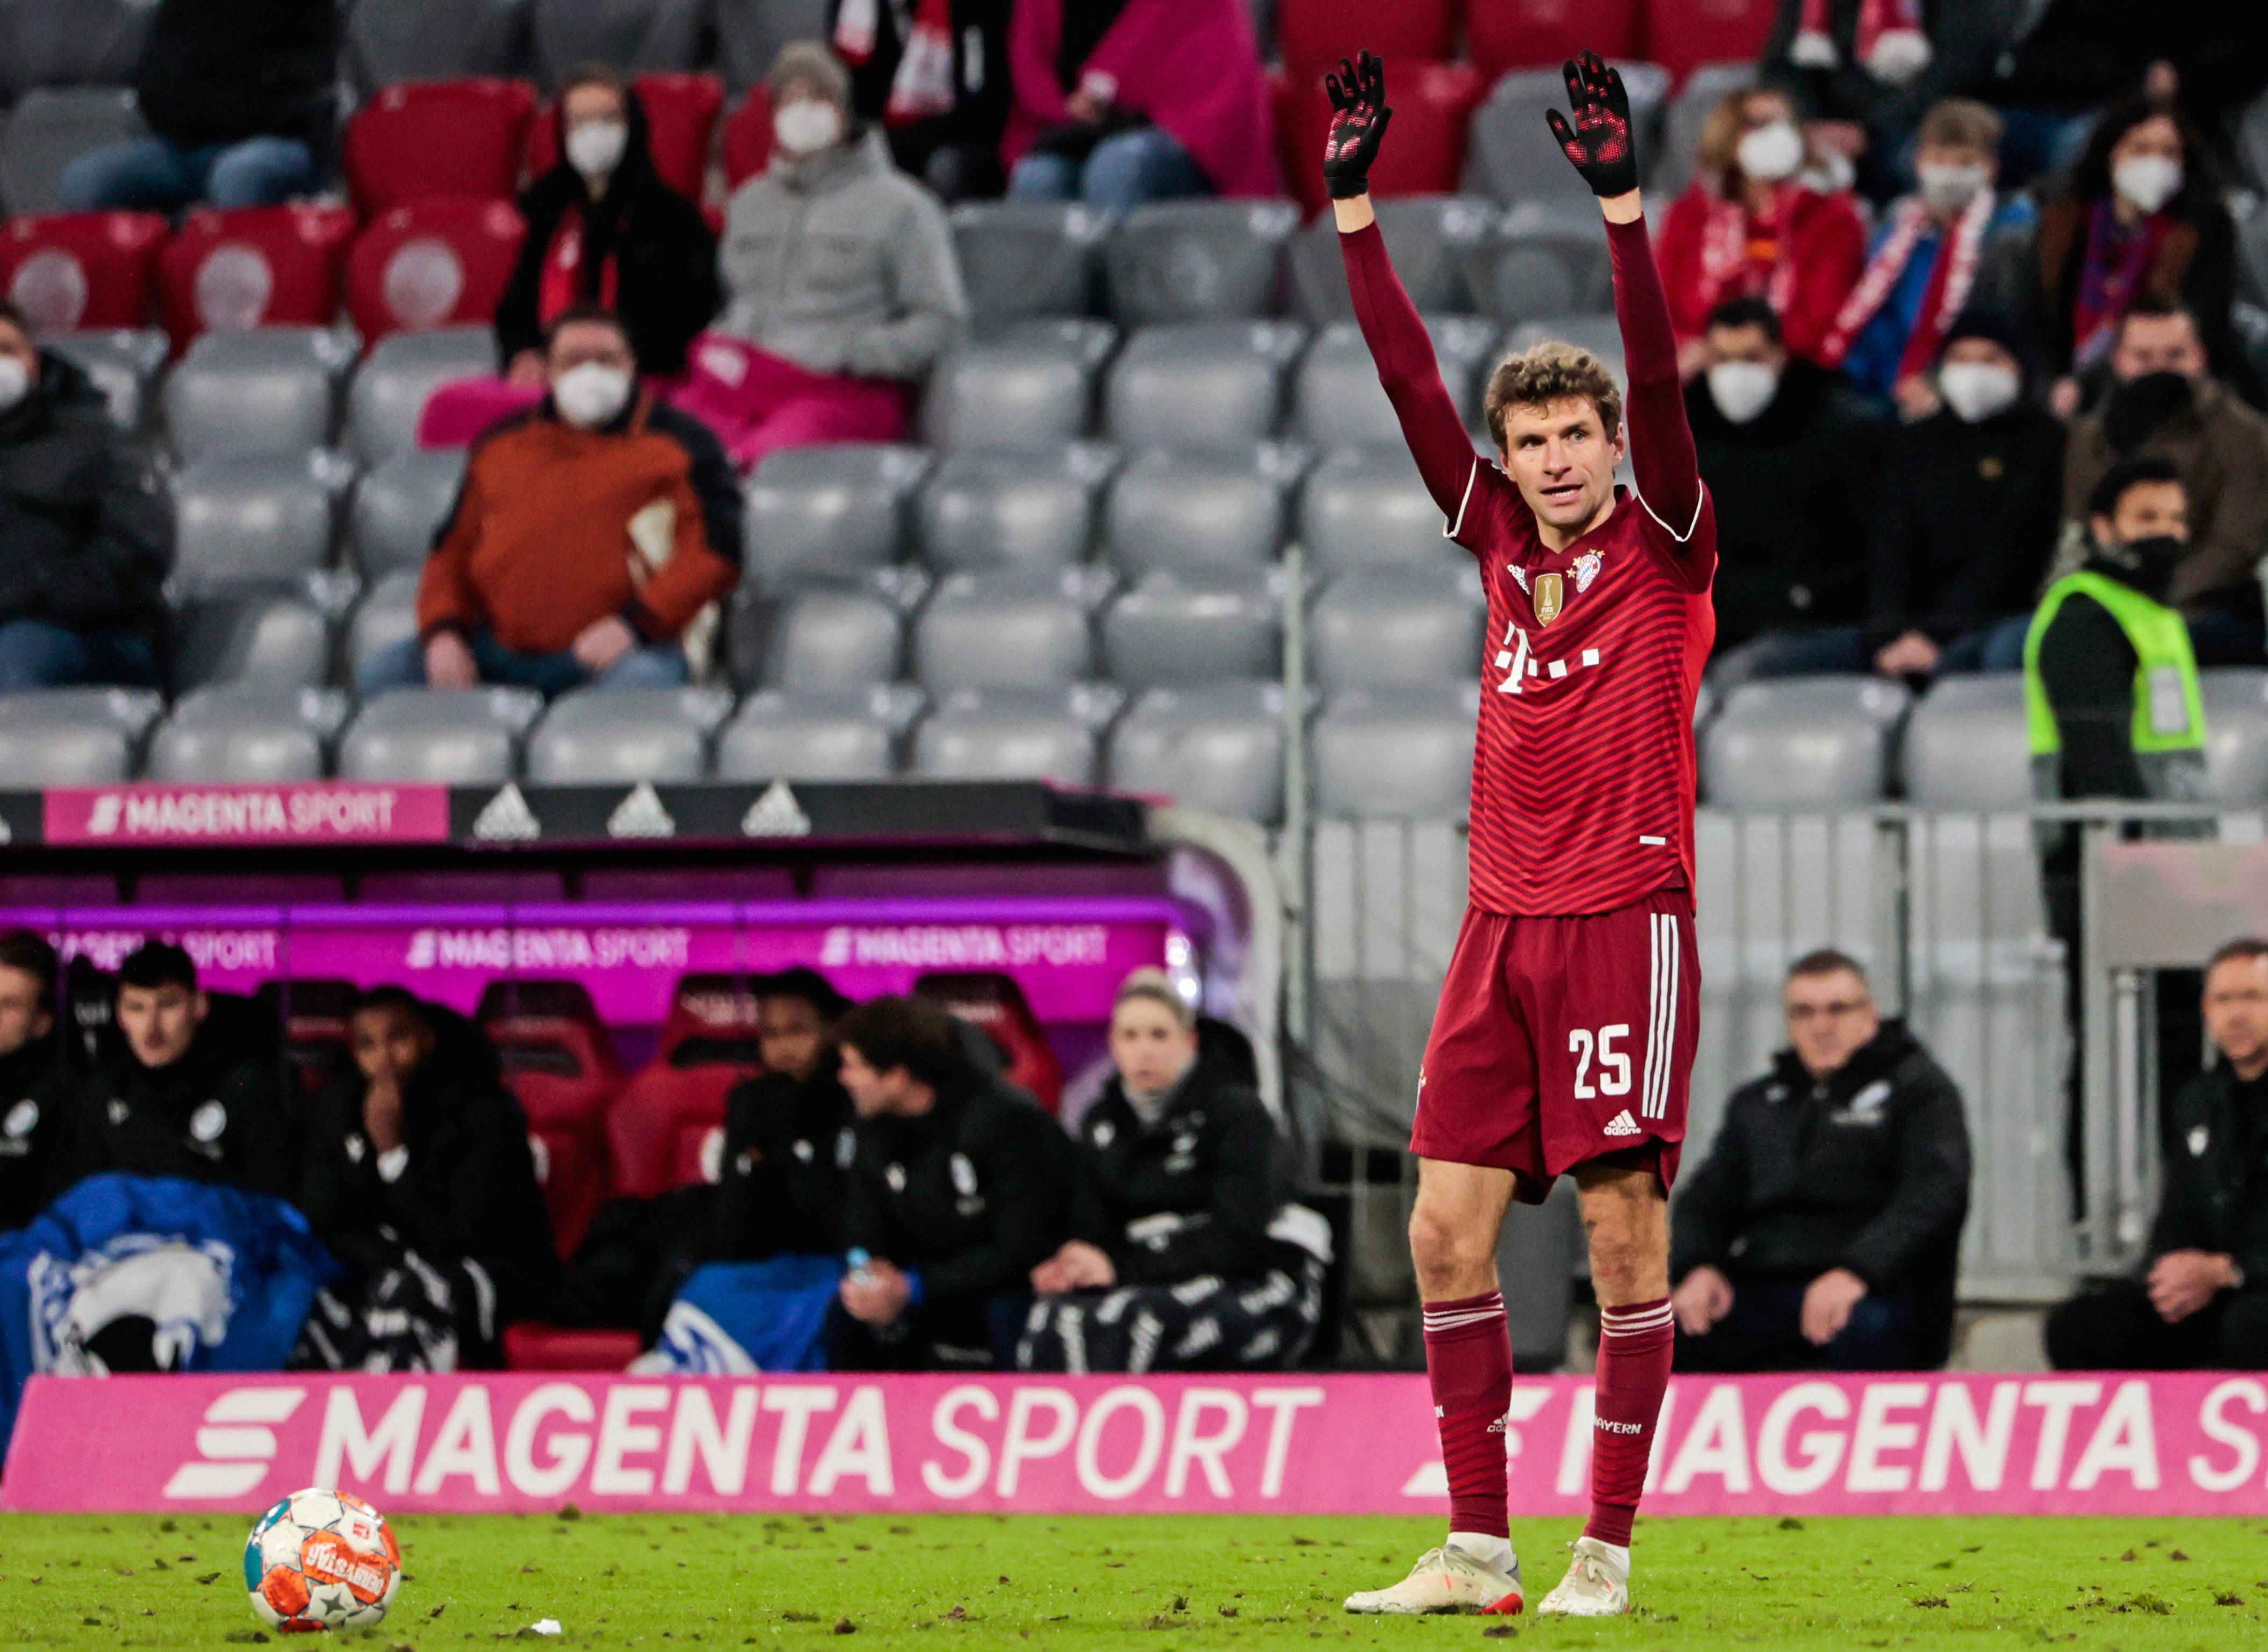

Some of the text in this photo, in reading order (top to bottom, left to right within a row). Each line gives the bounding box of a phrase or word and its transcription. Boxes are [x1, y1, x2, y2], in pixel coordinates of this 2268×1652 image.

[126, 791, 394, 835] MAGENTA SPORT
[438, 927, 689, 968] MAGENTA SPORT
[856, 925, 1107, 966] MAGENTA SPORT
[1569, 1023, 1631, 1099] 25
[313, 1383, 1325, 1499] MAGENTA SPORT
[2188, 1377, 2268, 1492] S
